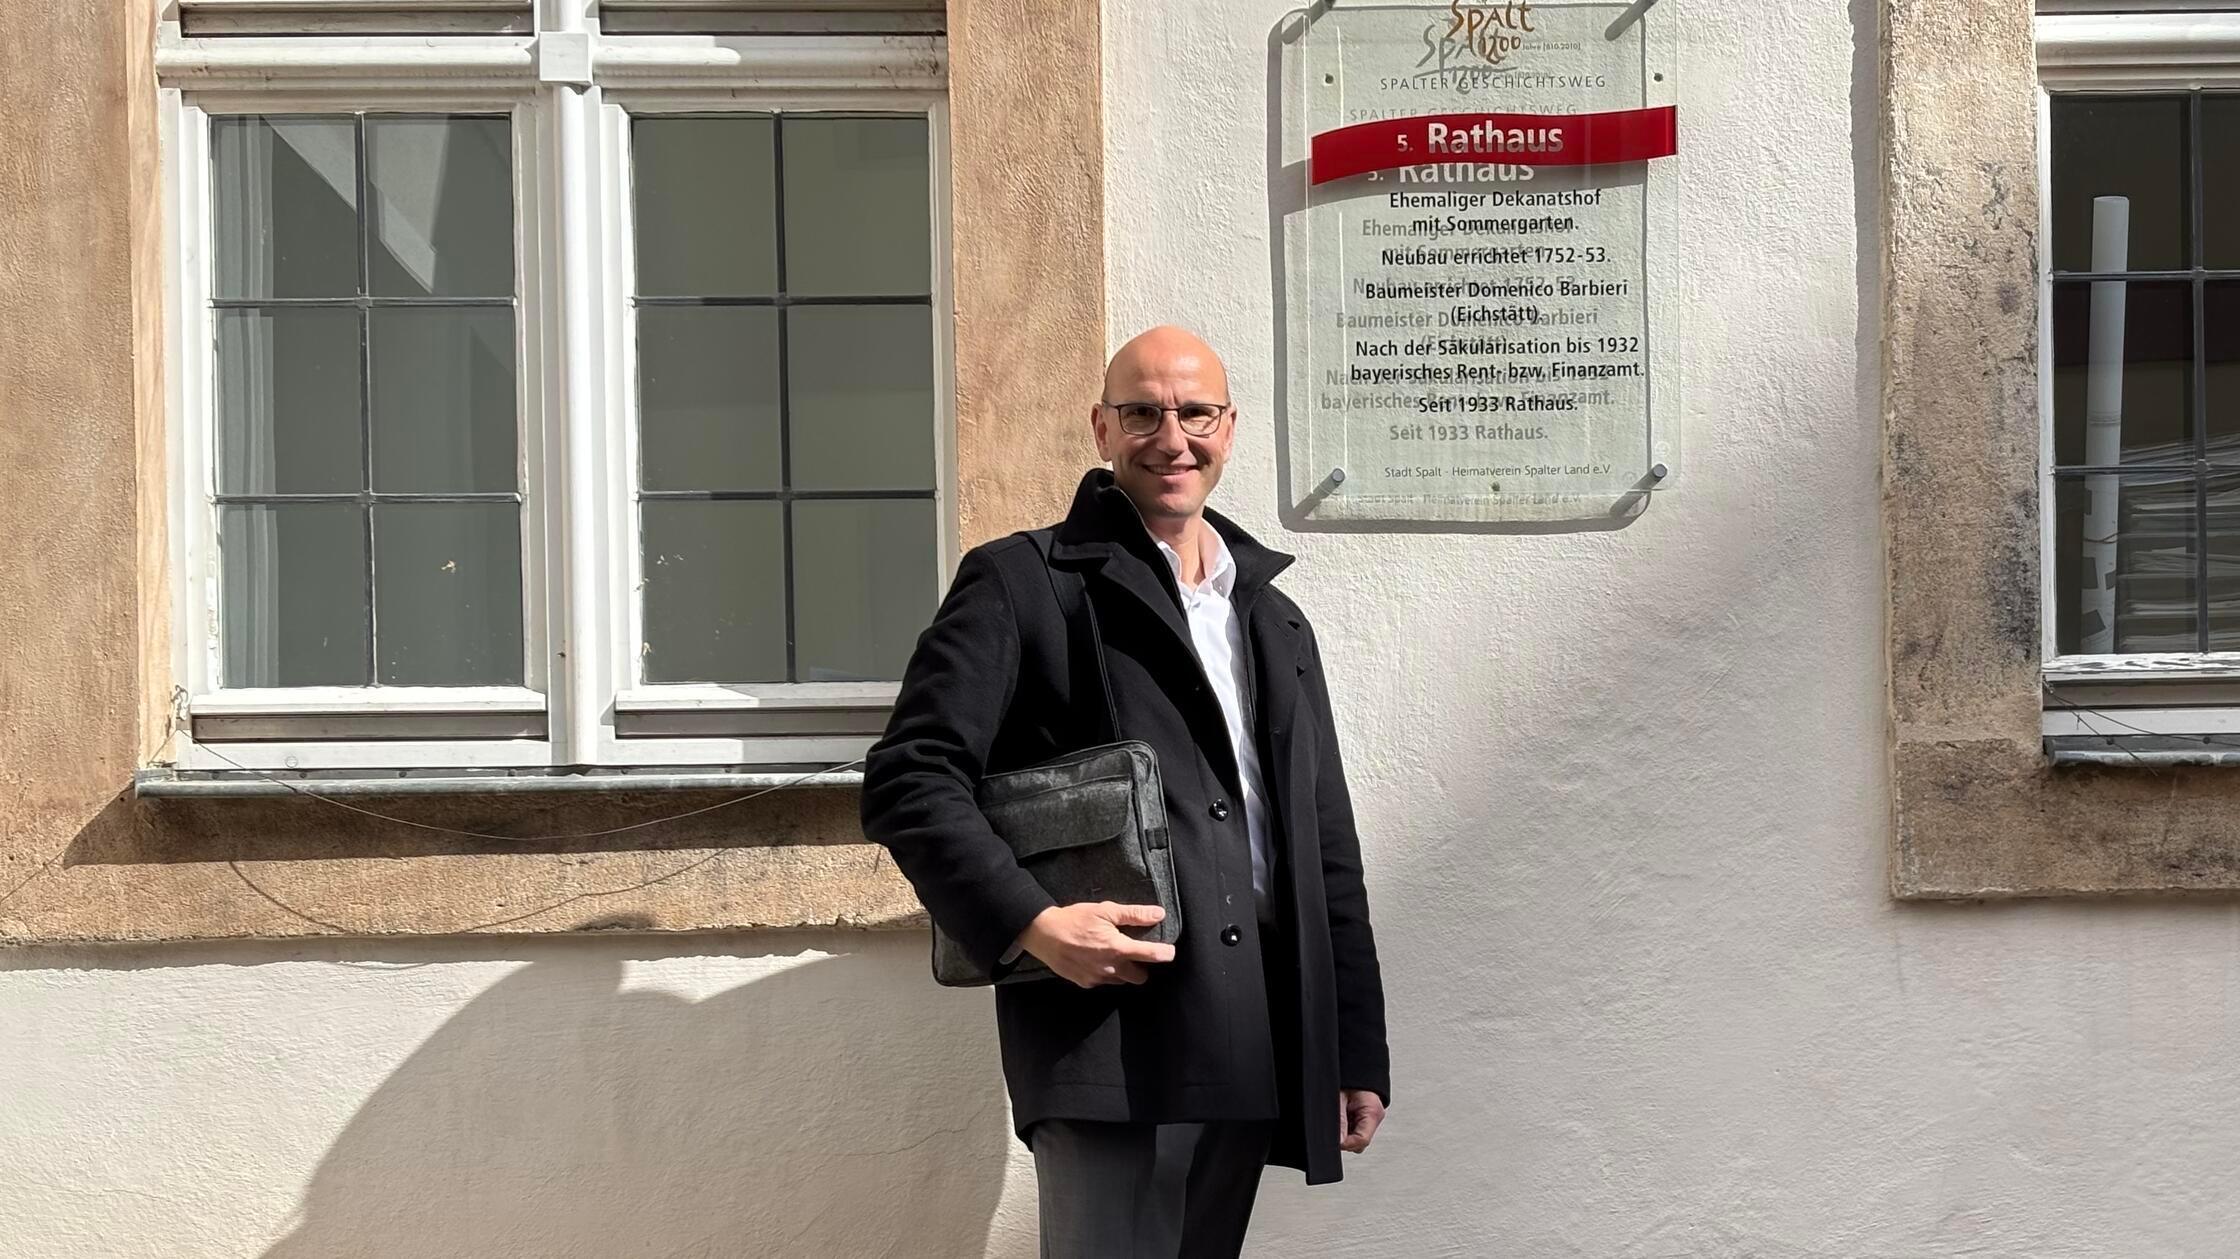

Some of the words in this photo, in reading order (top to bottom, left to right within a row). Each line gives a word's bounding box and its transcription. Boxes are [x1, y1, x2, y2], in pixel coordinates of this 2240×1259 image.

[1380, 77, 1449, 91] SPALTER
[1458, 75, 1606, 90] GESCHICHTSWEG
[1396, 134, 1414, 153] 5.
[1427, 119, 1564, 155] Rathaus
[1389, 191, 1487, 212] Ehemaliger
[1491, 188, 1602, 207] Dekanatshof
[1412, 215, 1441, 233] mit
[1446, 215, 1580, 235] Sommergarten.
[1381, 249, 1448, 266] Neubau
[1453, 247, 1529, 265] errichtet
[1365, 283, 1463, 299] Baumeister
[1468, 281, 1554, 298] Domenico
[1559, 279, 1629, 297] Barbieri
[1450, 304, 1544, 325] (Eichstätt).
[1355, 339, 1399, 357] Nach
[1403, 339, 1433, 356] der
[1437, 337, 1561, 356] Säkularisation
[1566, 336, 1591, 354] bis
[1597, 336, 1640, 354] 1932
[1350, 363, 1452, 385] bayerisches
[1456, 363, 1503, 380] Rent-
[1507, 361, 1547, 379] bzw.
[1551, 361, 1646, 378] Finanzamt.
[1418, 396, 1452, 413] Seit
[1457, 396, 1500, 413] 1933
[1504, 394, 1580, 412] Rathaus.
[1384, 466, 1413, 478] Stadt
[1415, 465, 1442, 479] Spalt
[1451, 464, 1522, 477] Heimatverein
[1524, 464, 1561, 477] Spalter
[1564, 463, 1590, 476] Land
